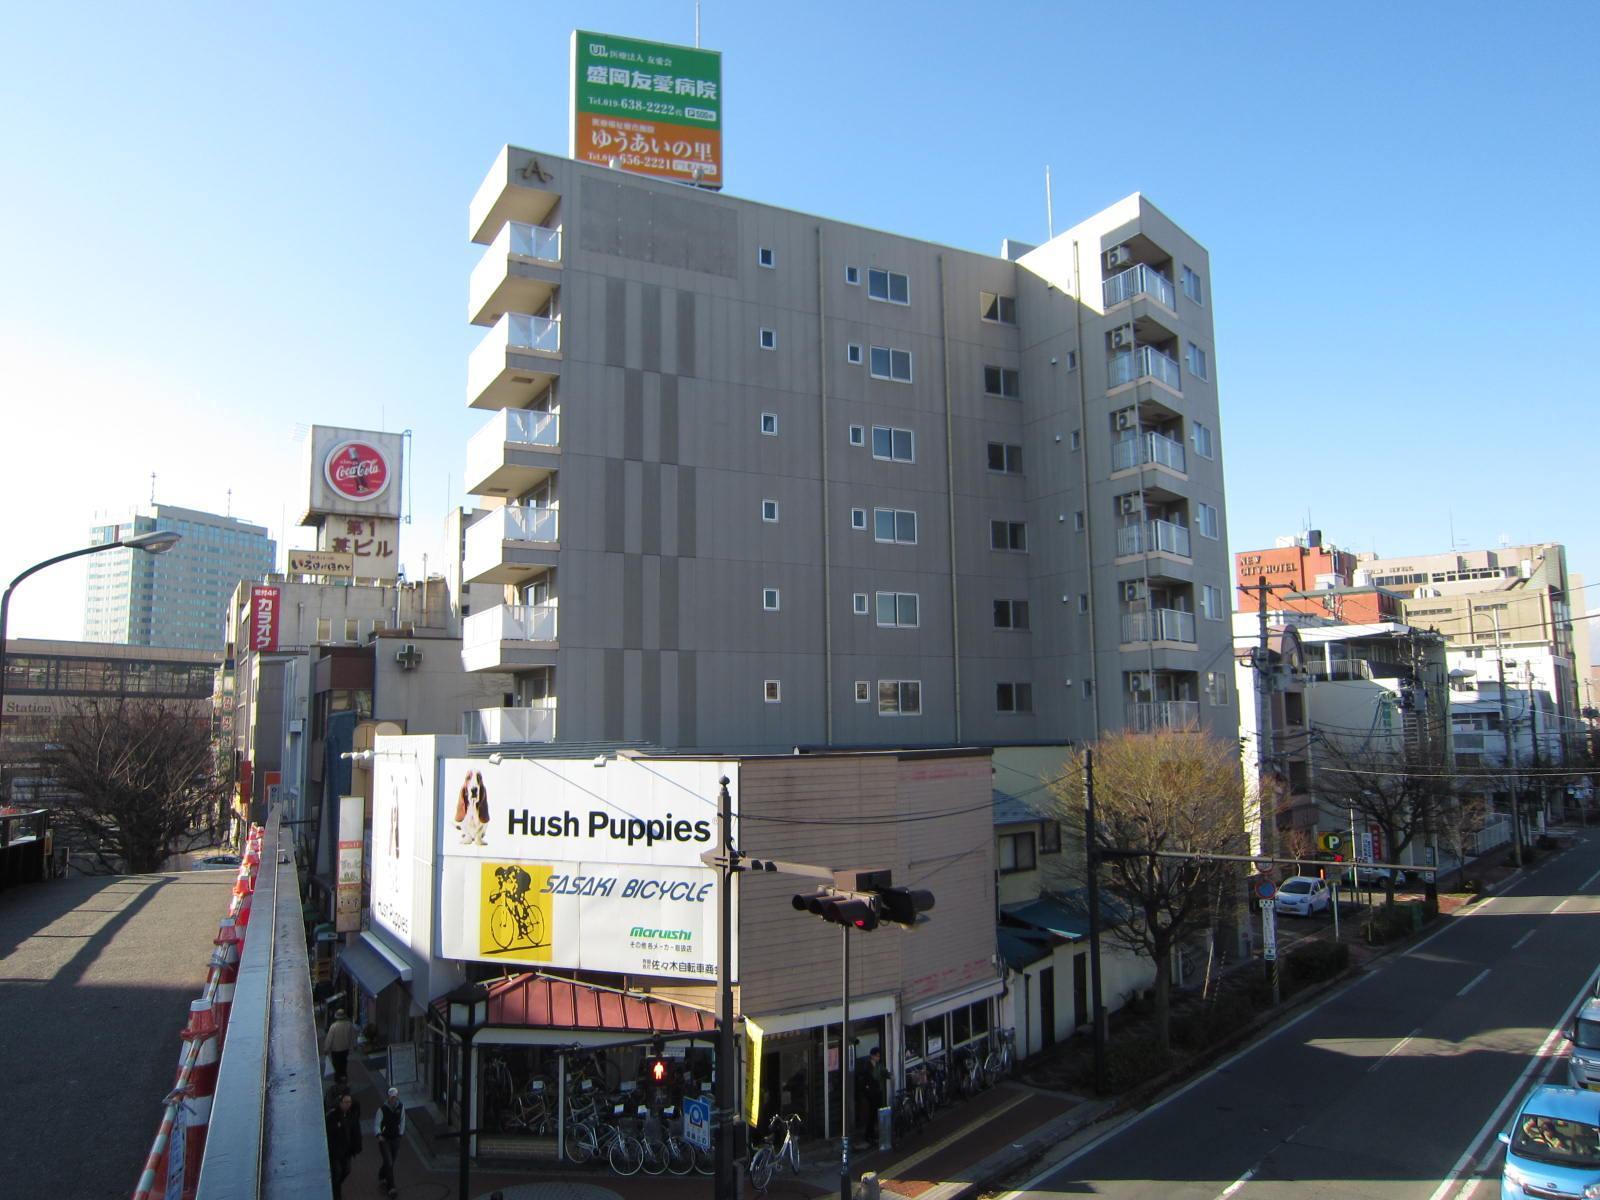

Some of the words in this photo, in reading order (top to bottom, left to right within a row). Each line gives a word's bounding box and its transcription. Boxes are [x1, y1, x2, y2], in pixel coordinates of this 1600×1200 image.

[586, 65, 717, 100] 盛岡友愛病院
[592, 129, 713, 162] ゆうあいの里
[1240, 555, 1261, 566] NEW
[1240, 566, 1263, 576] CITY
[1266, 563, 1298, 574] HOTEL
[257, 599, 273, 648] カラオケ
[6, 701, 51, 713] Station
[508, 808, 580, 837] Hush
[588, 811, 711, 847] Puppies
[1329, 836, 1340, 849] P
[540, 874, 617, 897] SASAKI
[621, 878, 714, 903] BICYCLE
